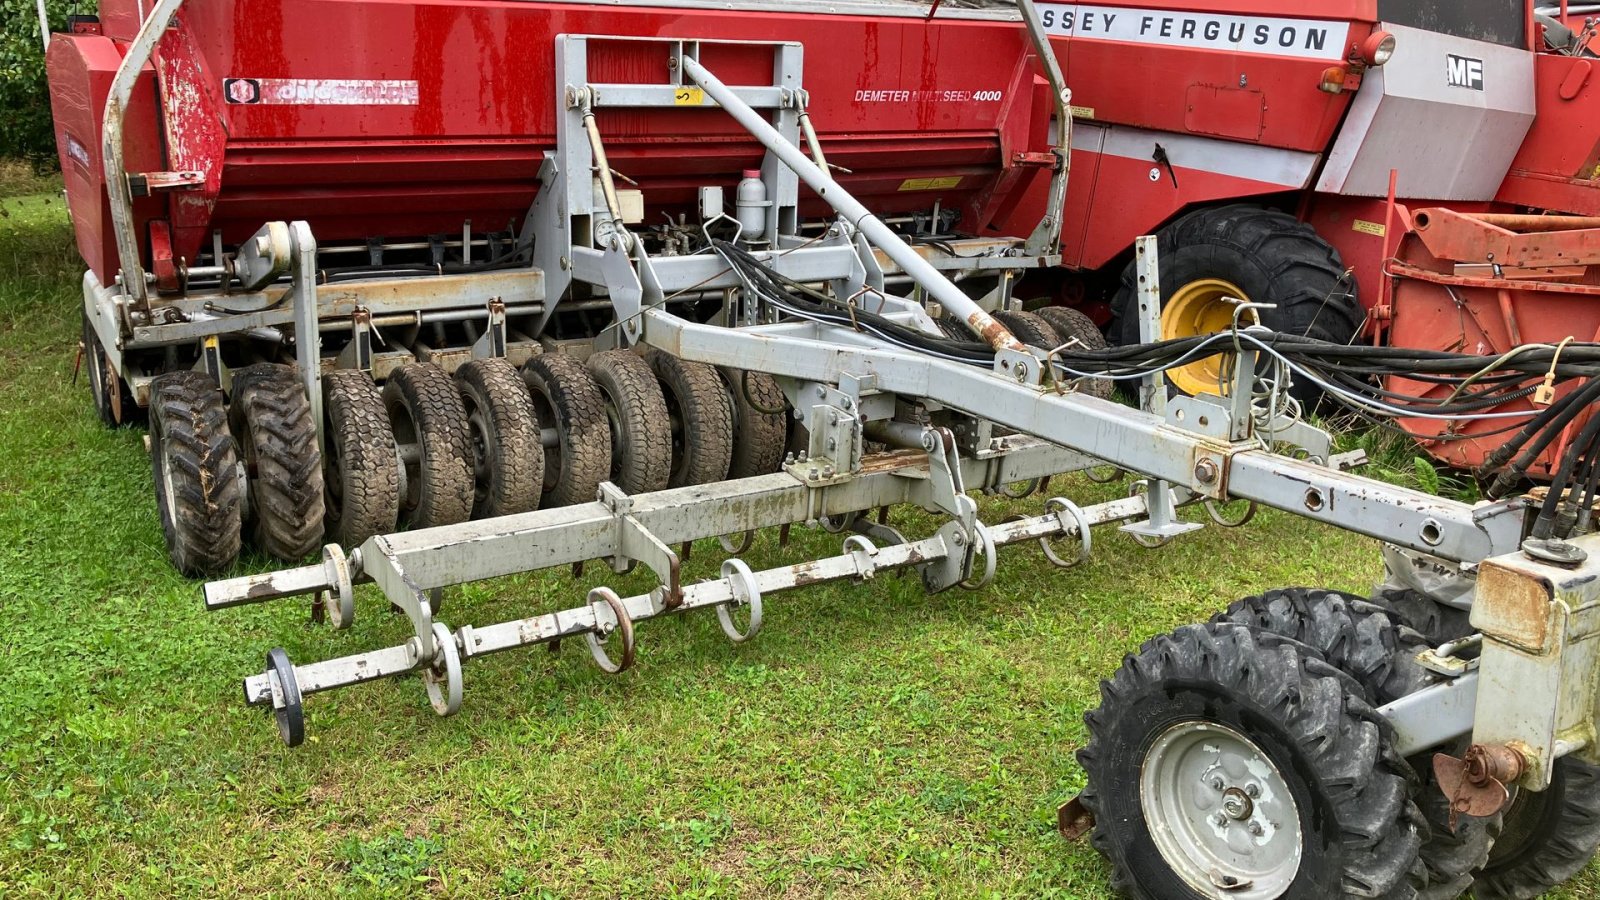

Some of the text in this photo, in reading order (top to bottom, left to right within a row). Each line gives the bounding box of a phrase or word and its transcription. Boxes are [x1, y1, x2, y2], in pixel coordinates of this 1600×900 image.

[1139, 16, 1328, 51] FERGUSON
[1447, 56, 1482, 88] MF
[854, 89, 910, 102] DEMETER
[972, 89, 1002, 101] 4000
